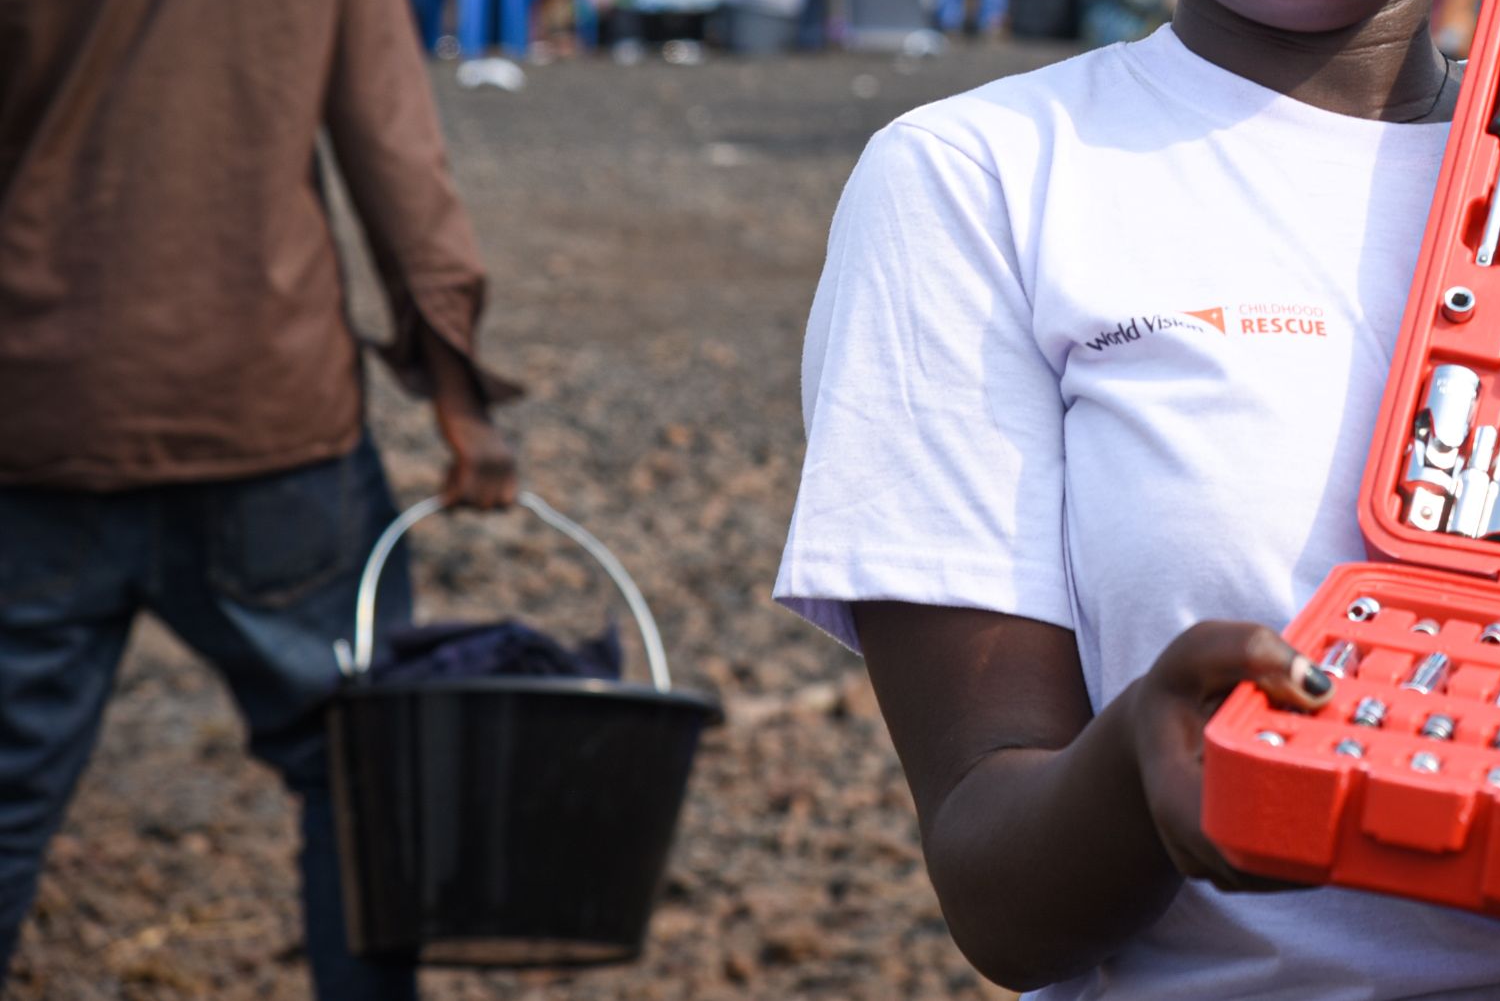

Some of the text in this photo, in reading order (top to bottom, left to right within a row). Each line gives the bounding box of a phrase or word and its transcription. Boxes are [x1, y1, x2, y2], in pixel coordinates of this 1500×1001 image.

[1239, 303, 1324, 318] CHILDHOOD
[1085, 317, 1141, 351] World
[1240, 317, 1327, 336] RESCUE
